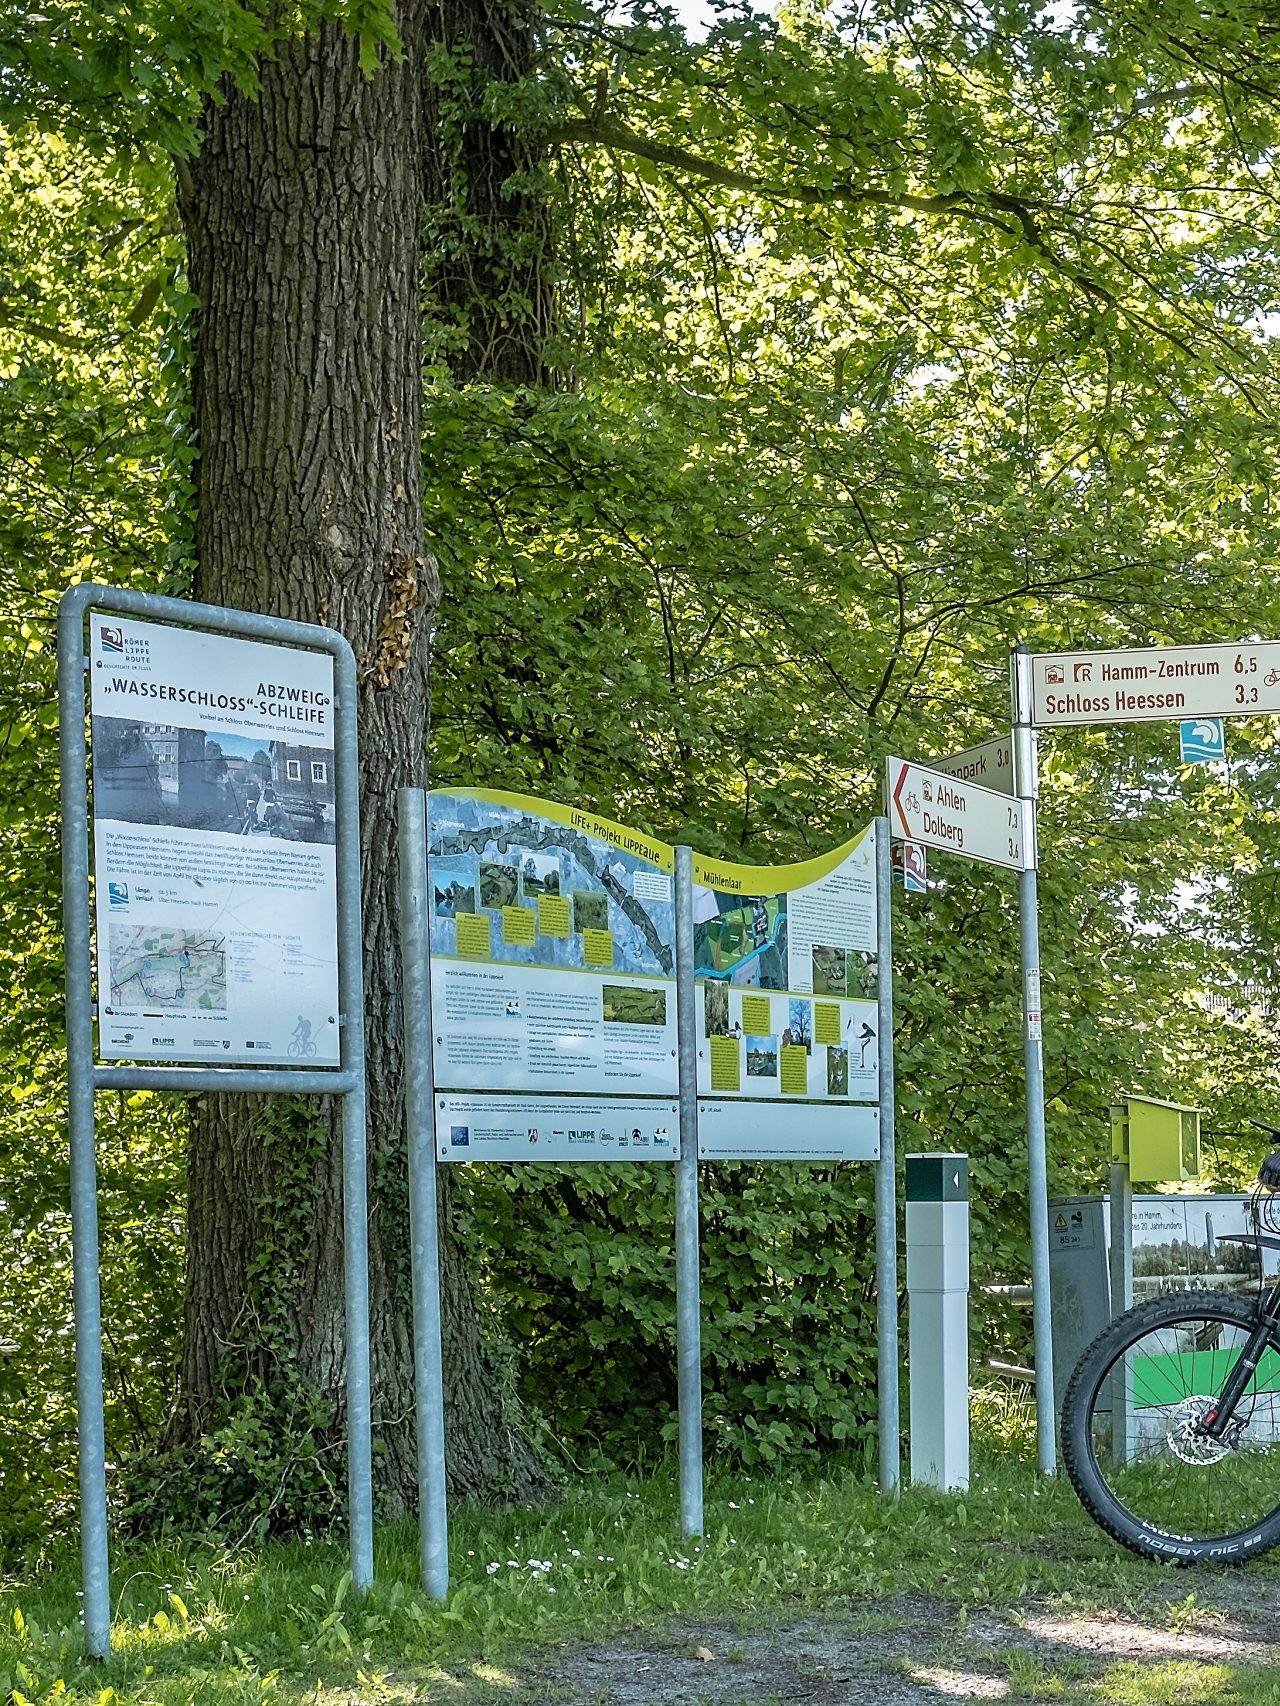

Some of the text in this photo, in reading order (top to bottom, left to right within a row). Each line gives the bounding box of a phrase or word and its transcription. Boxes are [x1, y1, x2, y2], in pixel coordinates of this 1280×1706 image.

[124, 637, 149, 646] RÖMER
[1102, 660, 1220, 681] Hamm-Zentrum
[1234, 654, 1257, 674] 6,5
[257, 682, 325, 706] ABZWEIG
[1046, 684, 1258, 714] Schloss Heessen 3,3
[997, 748, 1009, 768] 3,0
[936, 784, 1018, 829] Ahlen 7,3
[570, 813, 660, 863] LIFE+ Projekt LIPPEaue
[923, 811, 1019, 860] Dolberg 3,6
[703, 871, 742, 890] Mühlenlaar
[577, 1131, 595, 1139] LIPPE
[1144, 1211, 1162, 1221] Hamm,
[1150, 1221, 1183, 1231] Jahrhunderts
[1209, 1544, 1239, 1556] NIC
